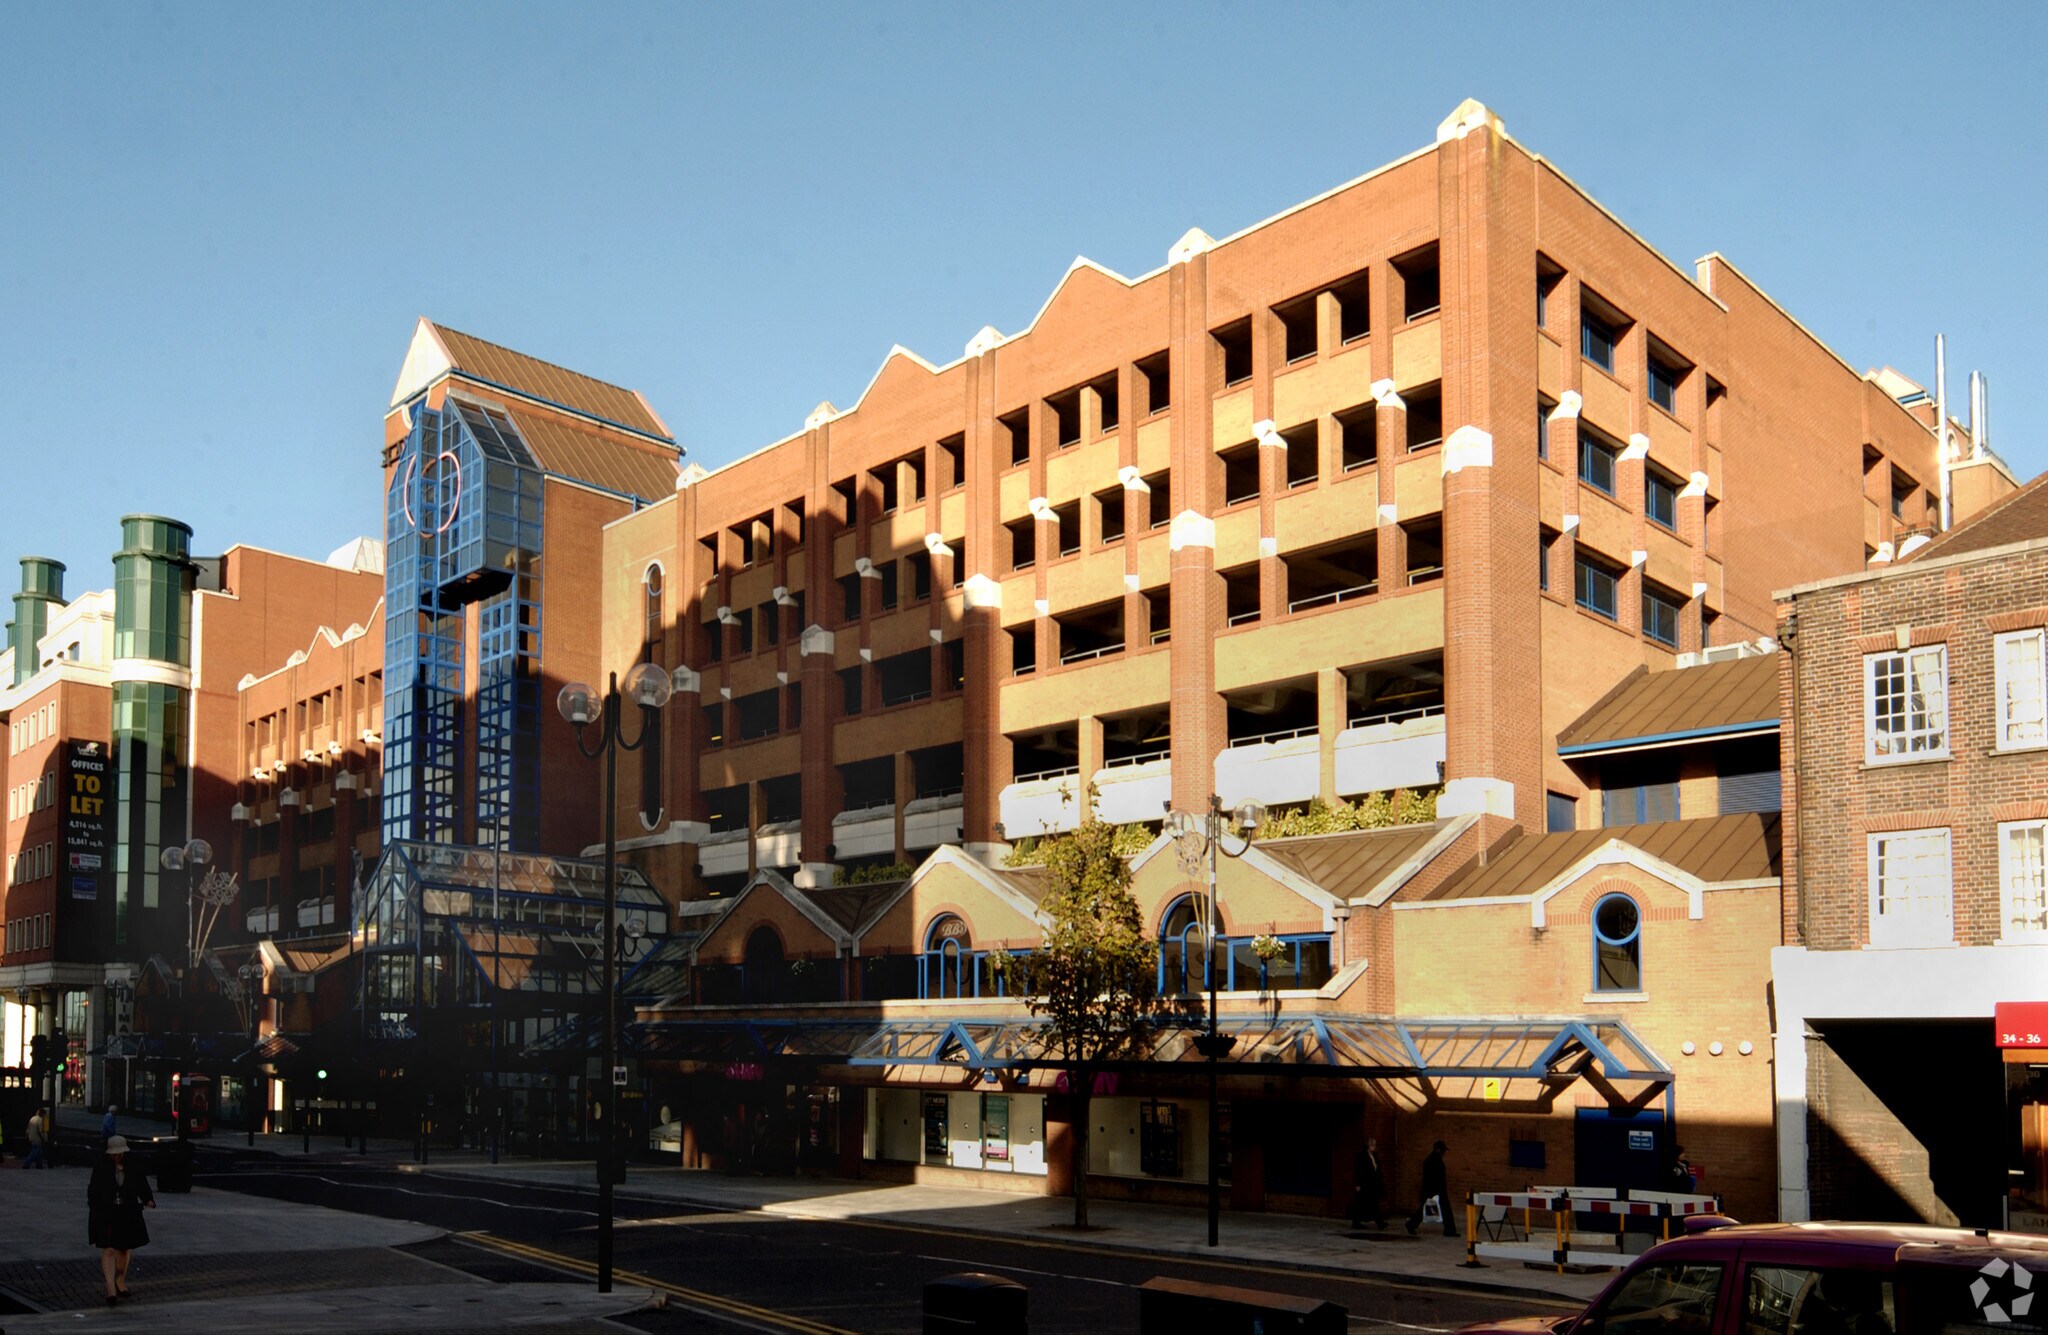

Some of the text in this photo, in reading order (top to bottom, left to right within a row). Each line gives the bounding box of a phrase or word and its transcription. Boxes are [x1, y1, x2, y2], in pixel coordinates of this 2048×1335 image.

[71, 759, 104, 771] OFFICES
[74, 773, 101, 794] TO
[70, 795, 104, 816] LET
[2002, 1033, 2016, 1043] 34
[2026, 1033, 2042, 1043] 36
